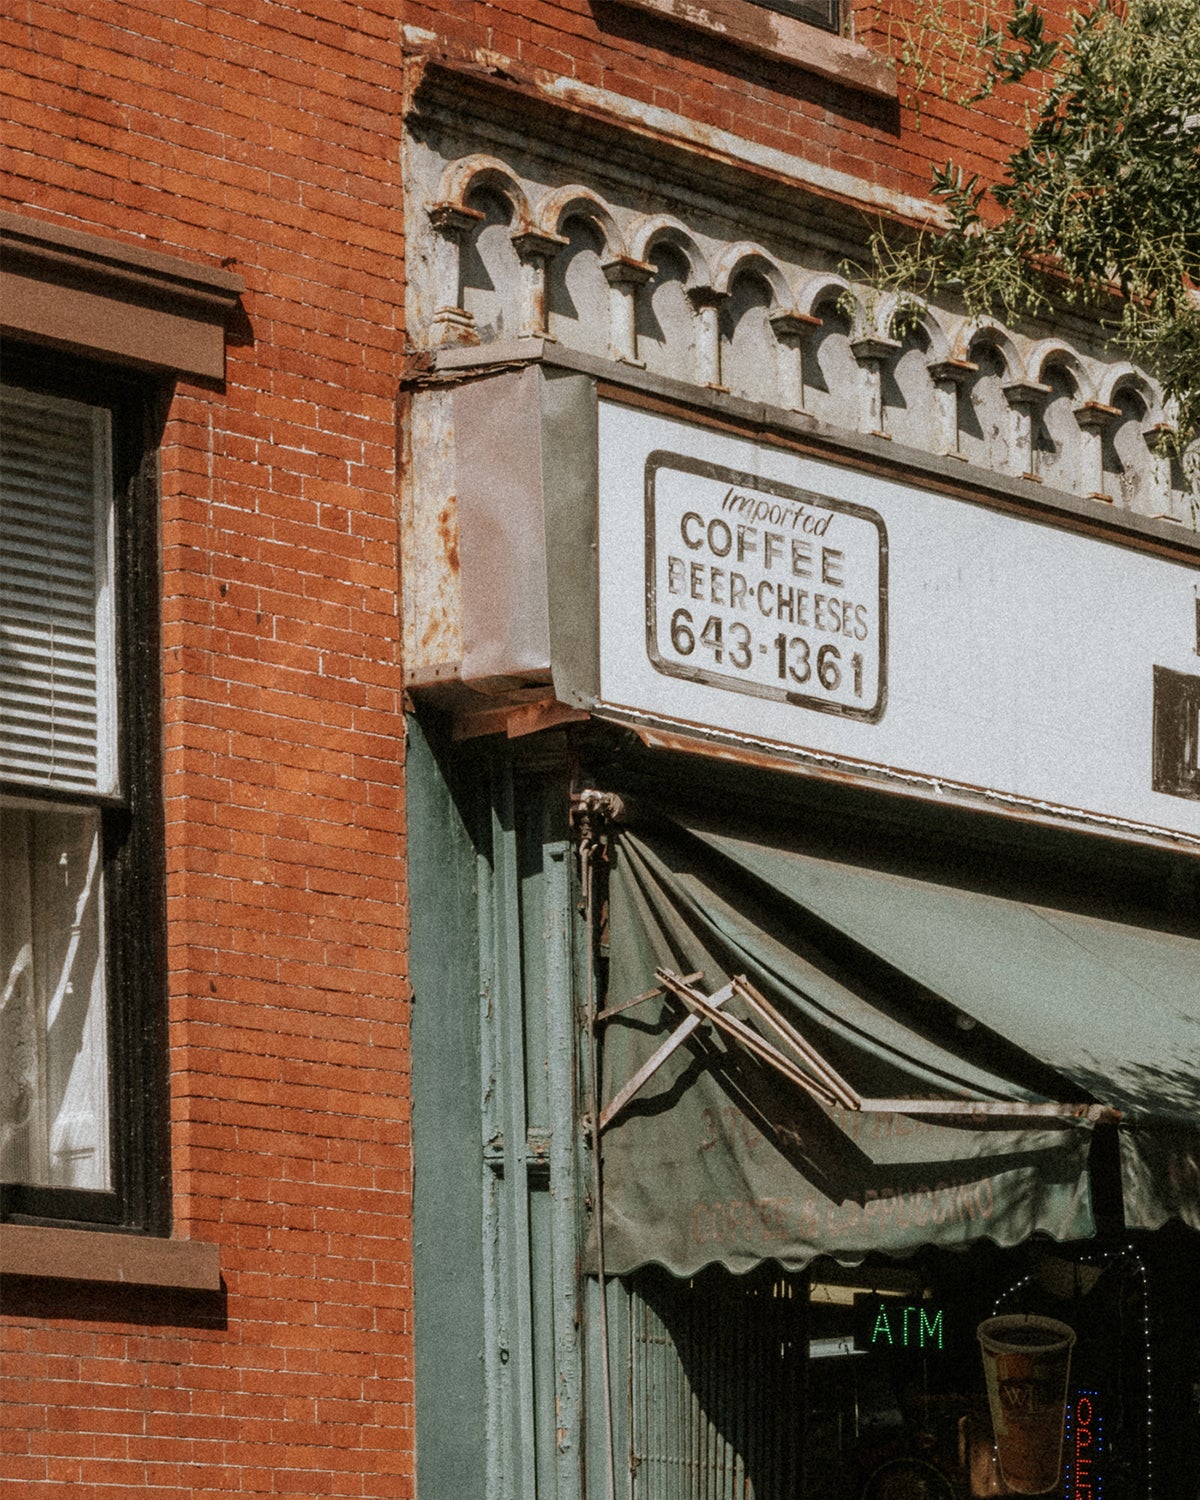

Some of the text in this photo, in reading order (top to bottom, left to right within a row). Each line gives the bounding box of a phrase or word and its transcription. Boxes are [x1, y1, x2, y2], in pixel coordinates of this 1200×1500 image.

[721, 487, 834, 537] Imported
[680, 511, 845, 588] COFFEE
[670, 607, 863, 699] 643-1361
[690, 1174, 996, 1245] COFFEE & CAPPUCCINO
[871, 1303, 944, 1350] ATM
